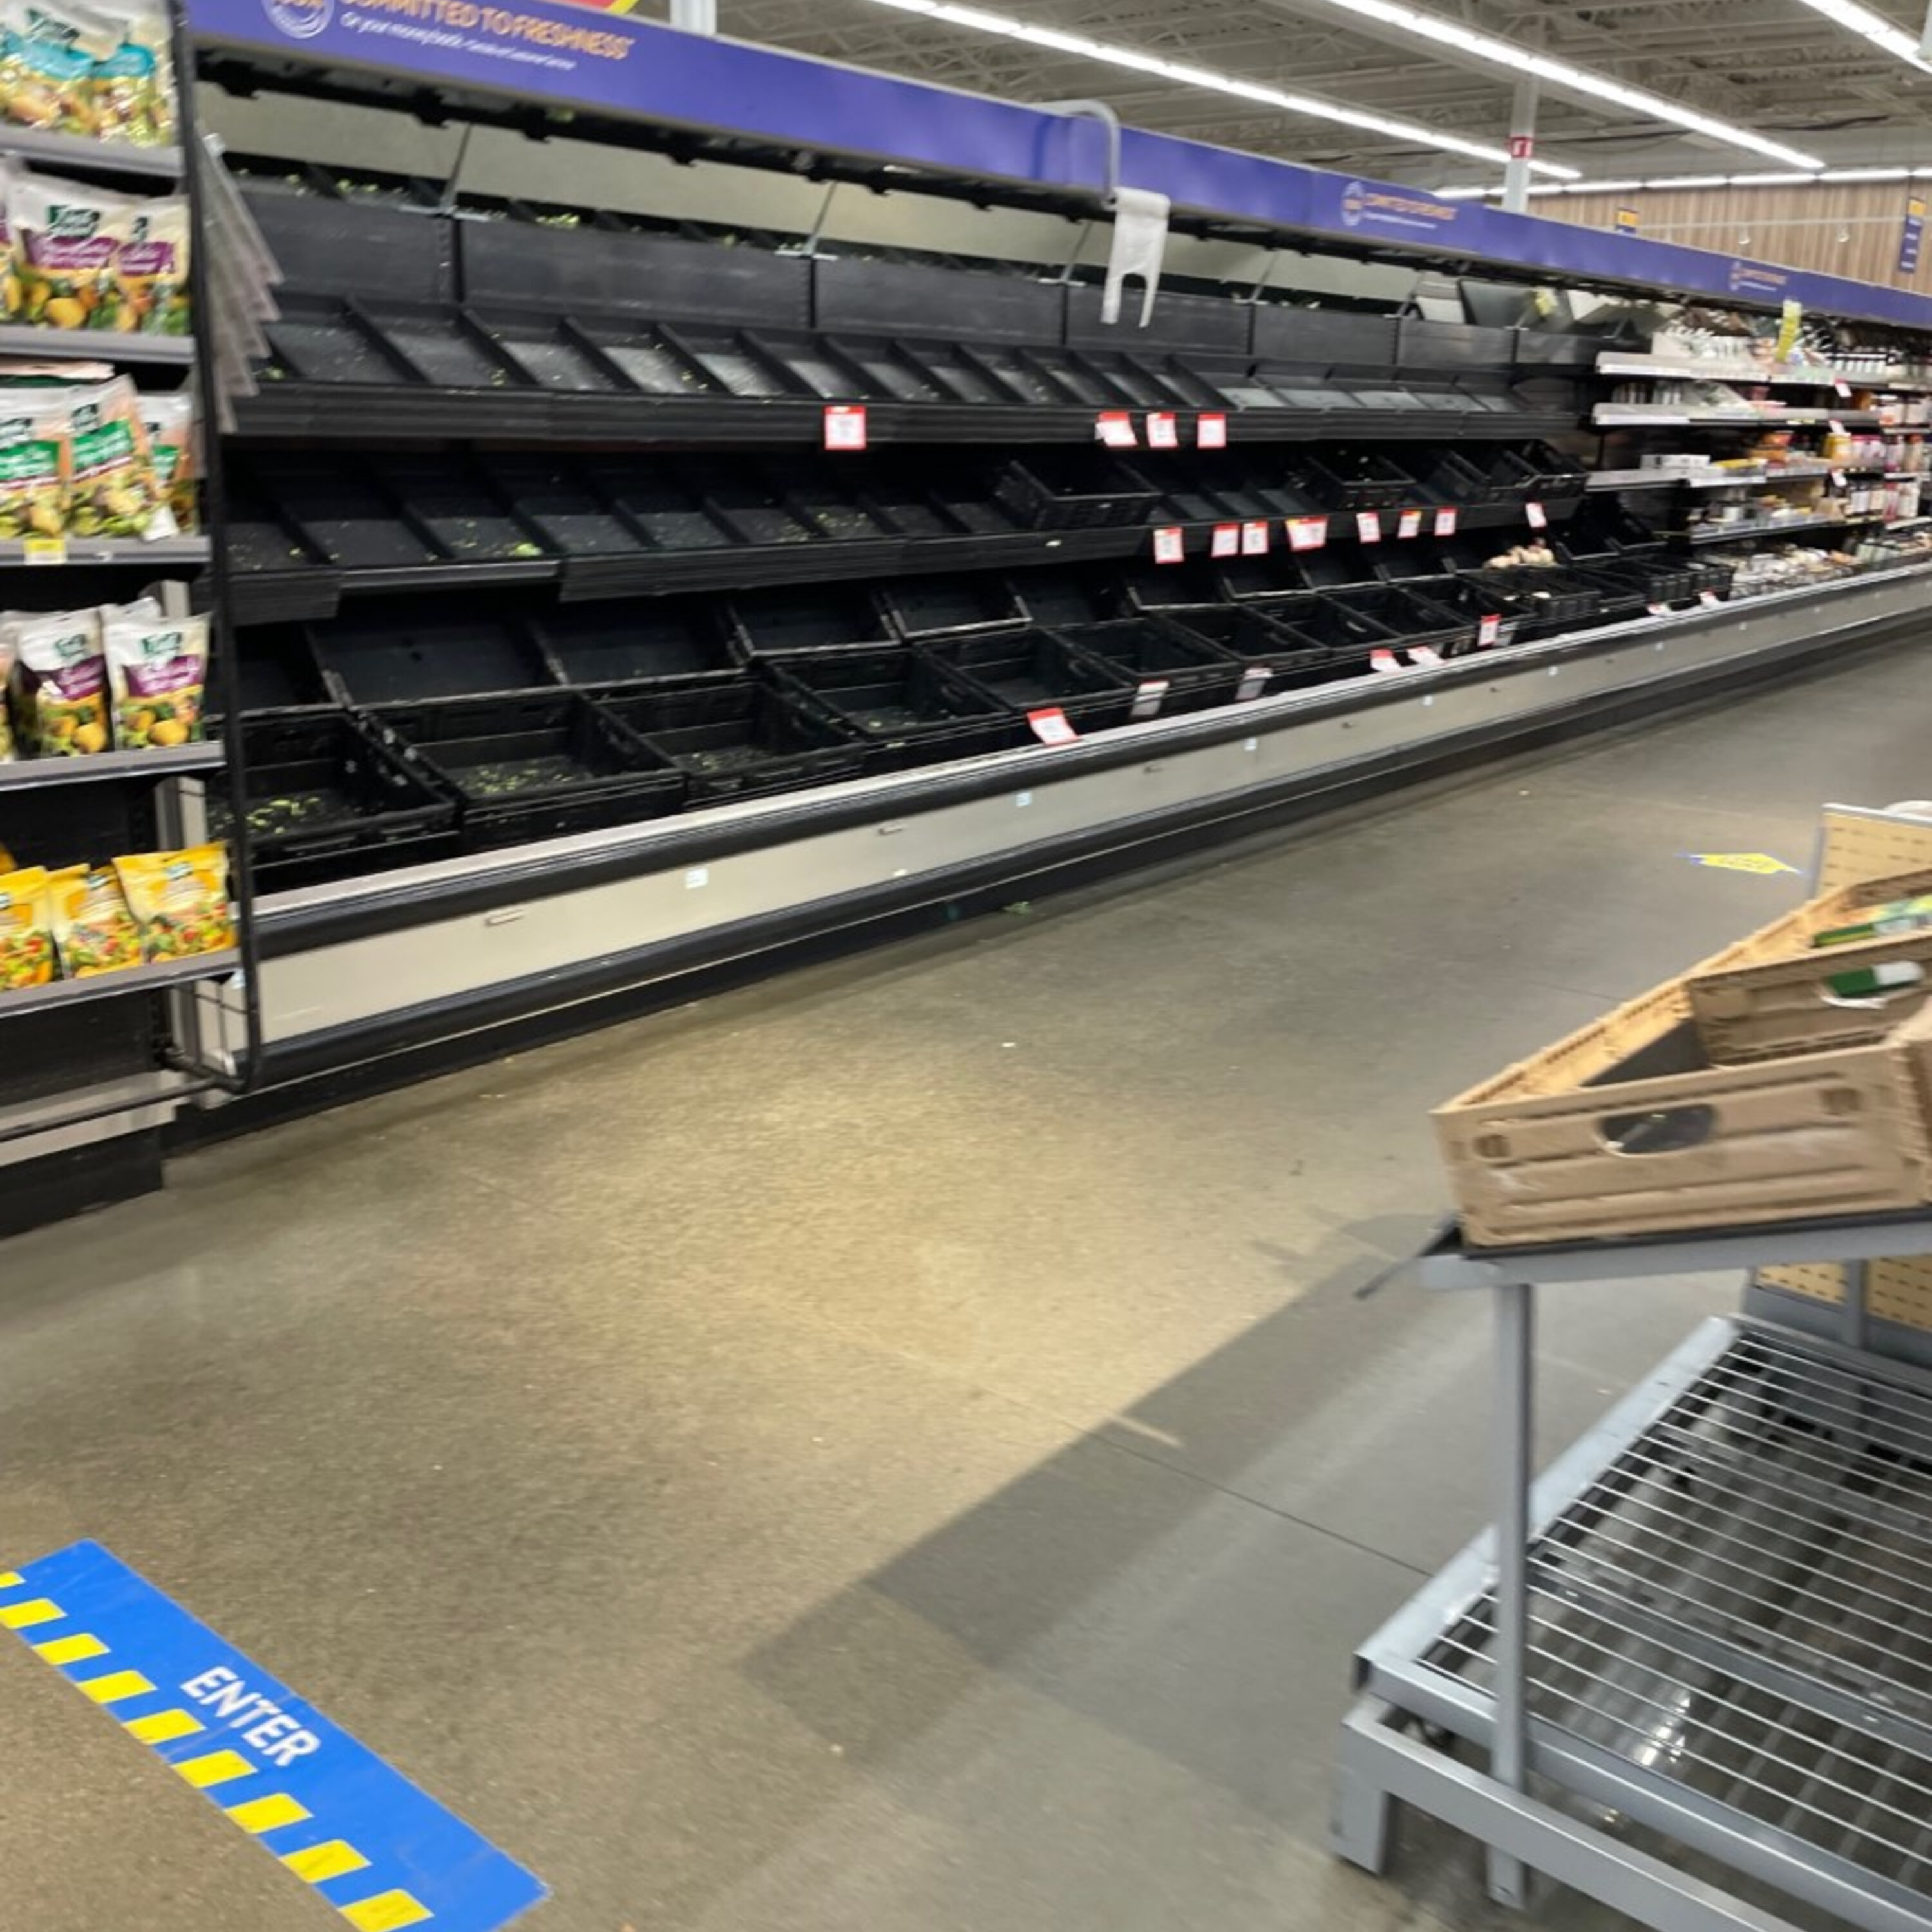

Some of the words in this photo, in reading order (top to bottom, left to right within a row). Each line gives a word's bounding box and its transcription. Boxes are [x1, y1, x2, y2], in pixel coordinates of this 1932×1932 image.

[340, 0, 480, 28] MITTED
[480, 8, 513, 35] TO
[180, 1666, 321, 1766] ENTER
